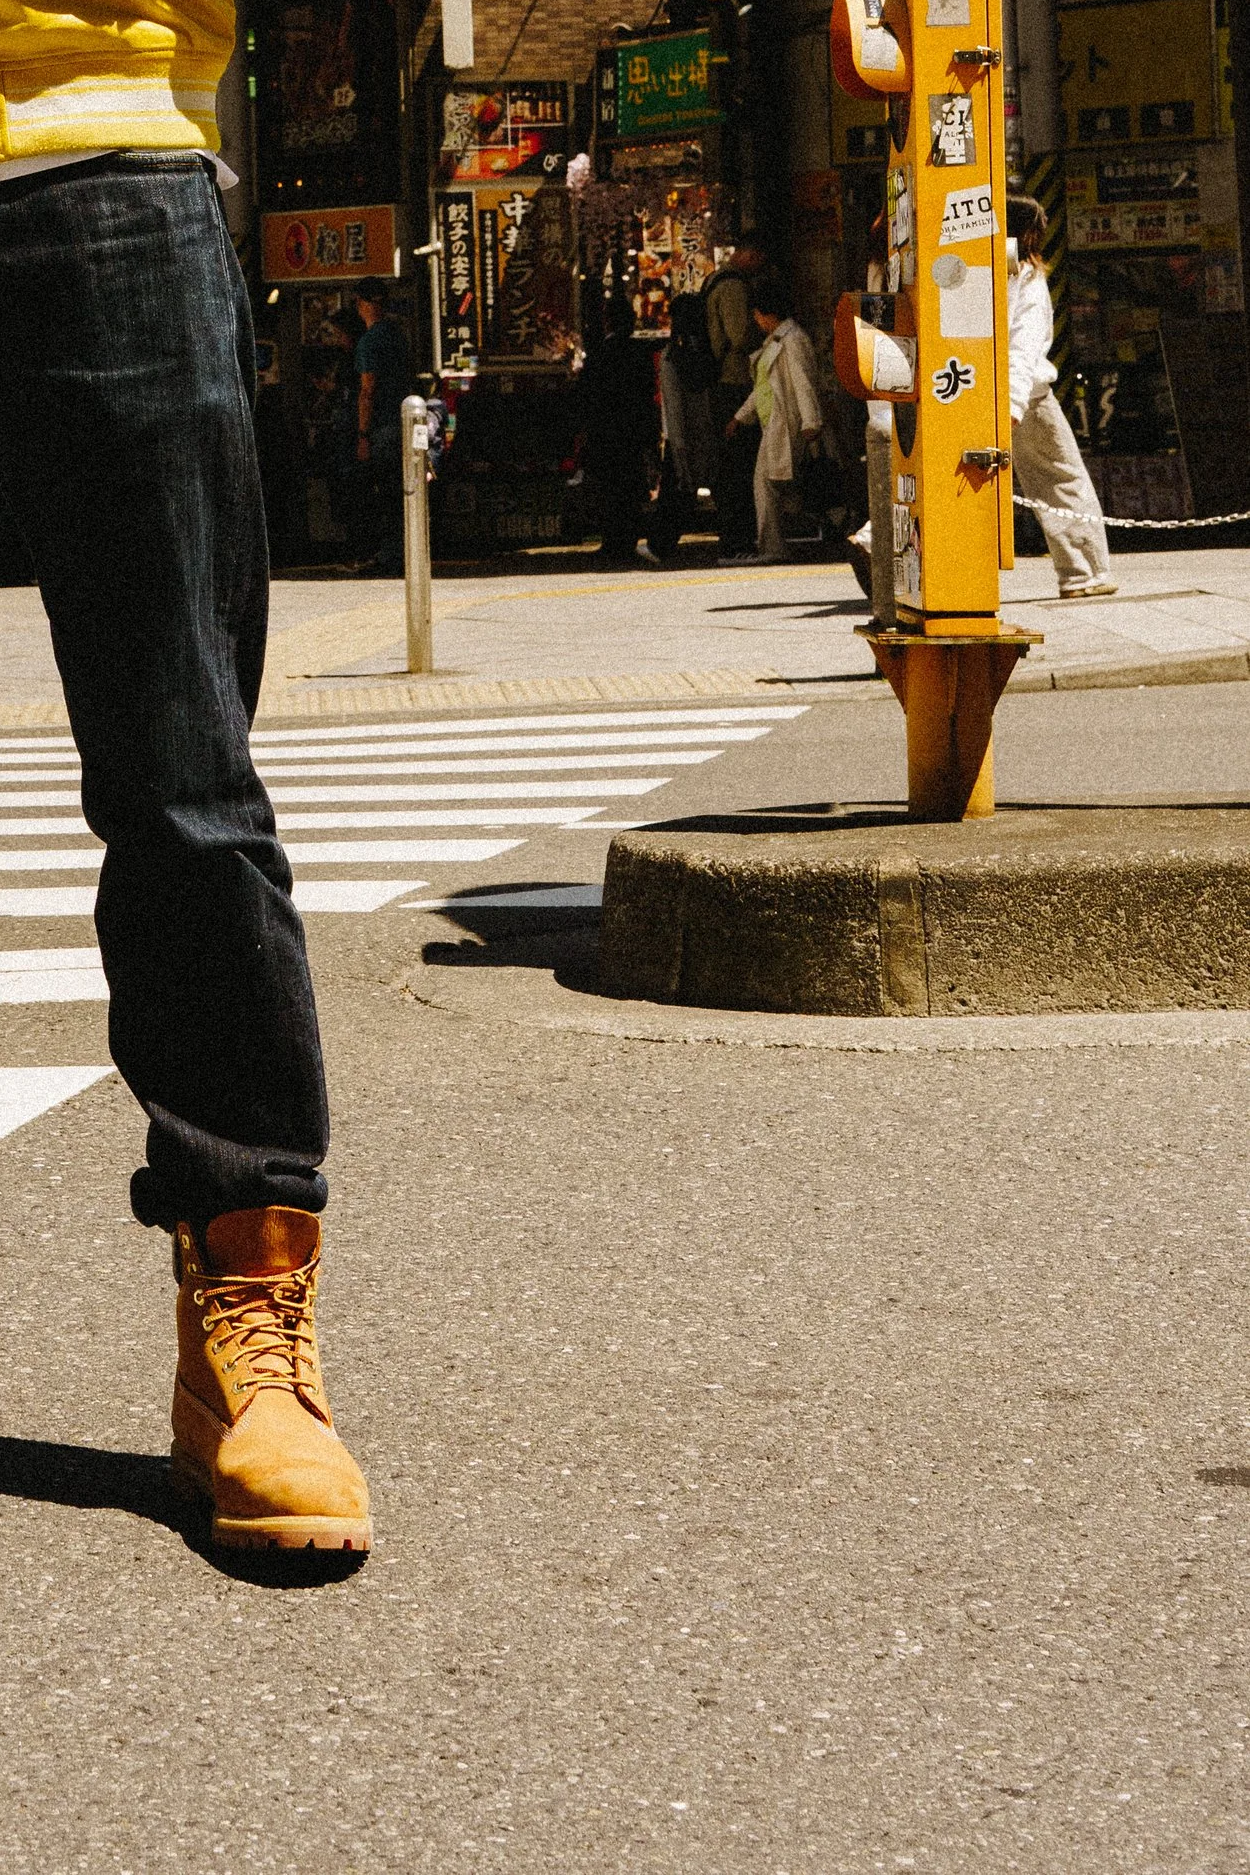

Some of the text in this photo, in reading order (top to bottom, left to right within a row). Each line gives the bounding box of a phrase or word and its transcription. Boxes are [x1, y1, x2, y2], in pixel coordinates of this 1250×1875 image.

[315, 222, 367, 267] 松屋
[447, 202, 471, 296] 餃子の安亭
